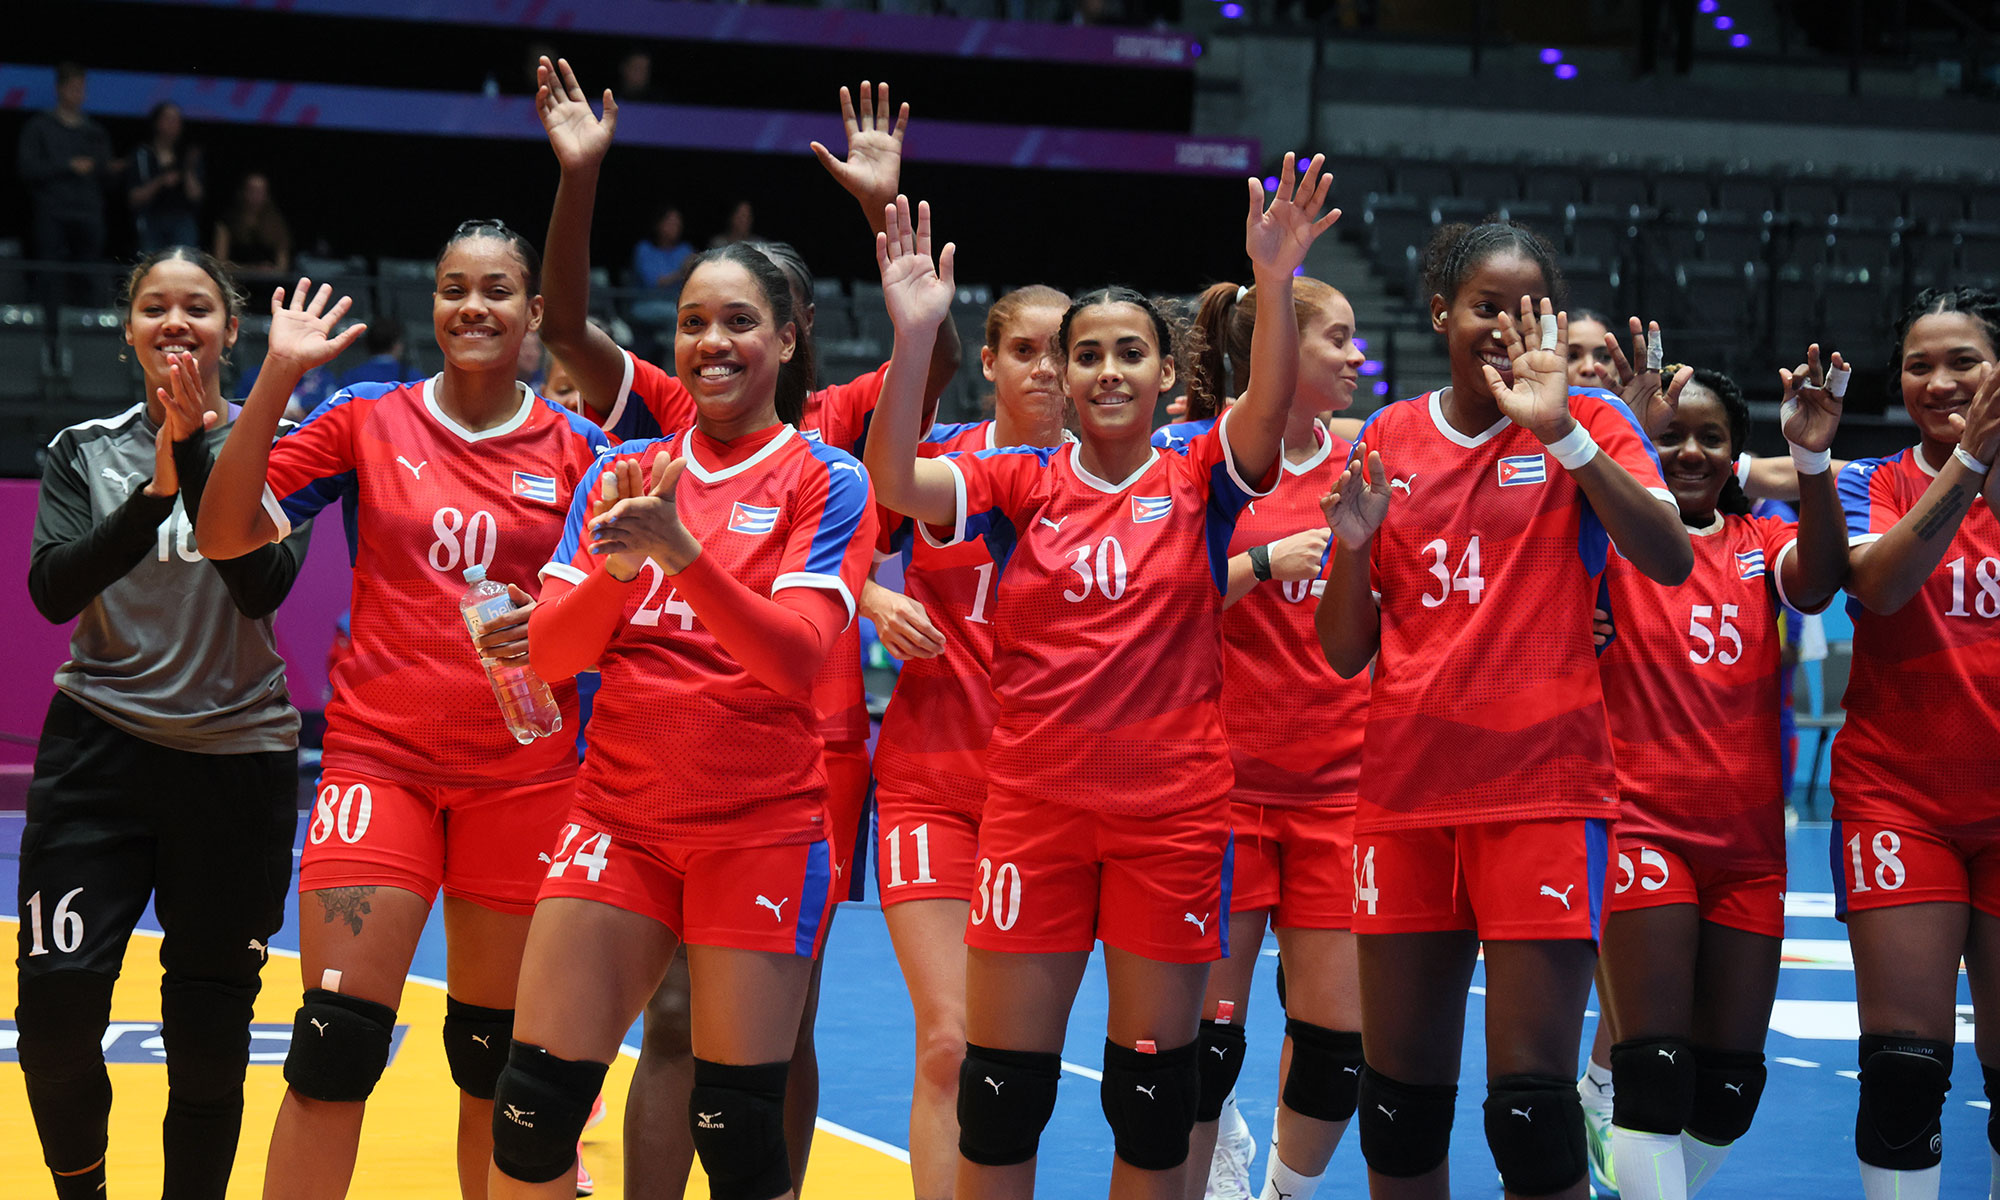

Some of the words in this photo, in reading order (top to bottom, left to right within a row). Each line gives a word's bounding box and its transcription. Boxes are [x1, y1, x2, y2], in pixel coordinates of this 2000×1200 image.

[429, 507, 497, 571] 80
[1064, 536, 1127, 602] 30
[630, 556, 697, 631] 24
[1421, 536, 1484, 607] 34
[1945, 556, 2000, 618] 18
[1689, 604, 1742, 665] 55
[310, 784, 372, 844] 80
[547, 823, 612, 882] 24
[886, 823, 936, 888] 11
[1848, 831, 1905, 892] 18
[27, 887, 83, 956] 16
[972, 858, 1021, 930] 30
